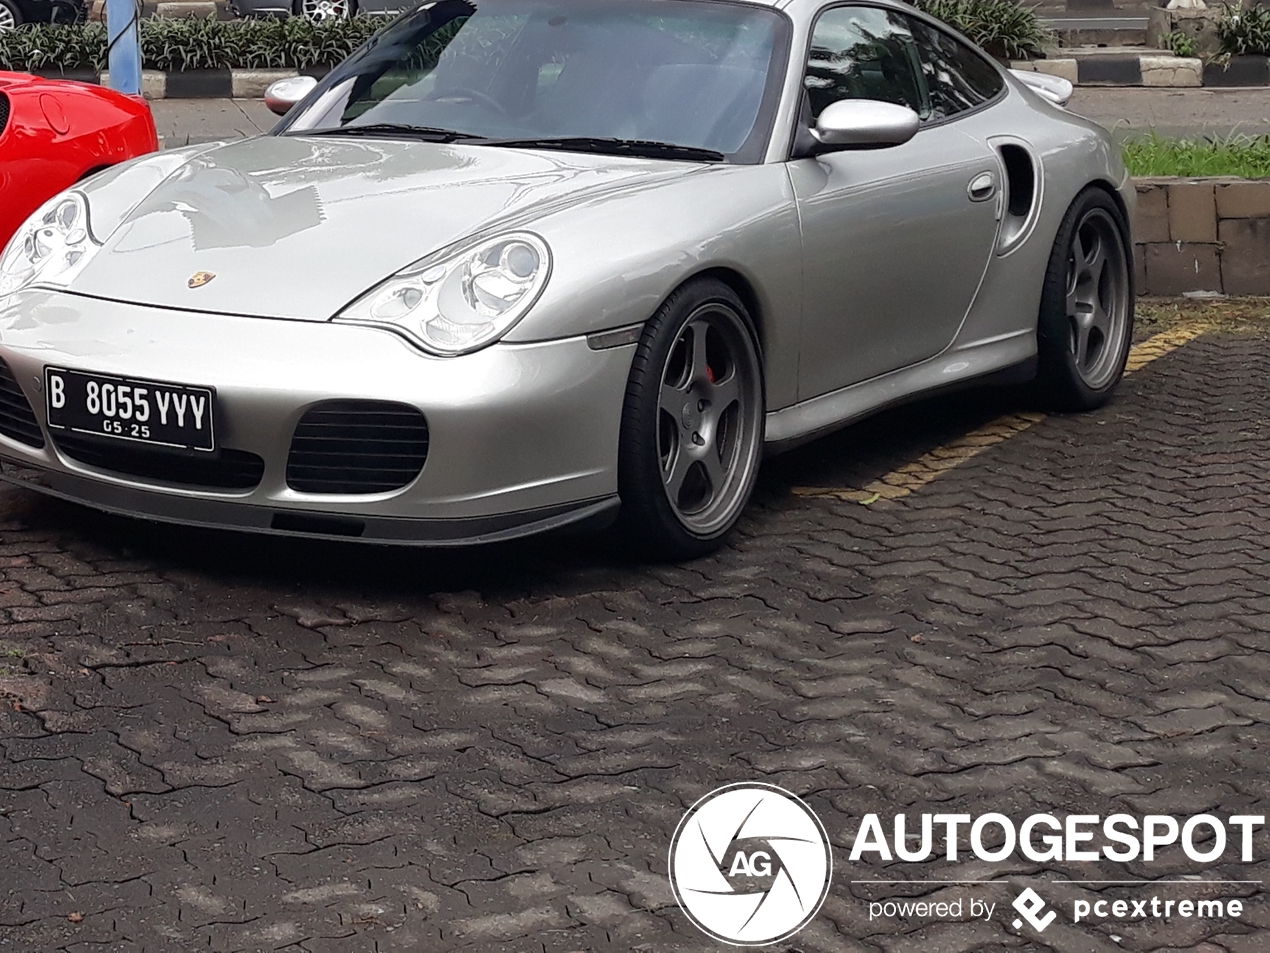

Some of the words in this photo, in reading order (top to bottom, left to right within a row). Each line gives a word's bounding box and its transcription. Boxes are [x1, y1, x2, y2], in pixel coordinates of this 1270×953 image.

[50, 375, 66, 409] B
[86, 381, 150, 422] 8055
[155, 391, 205, 430] YYY
